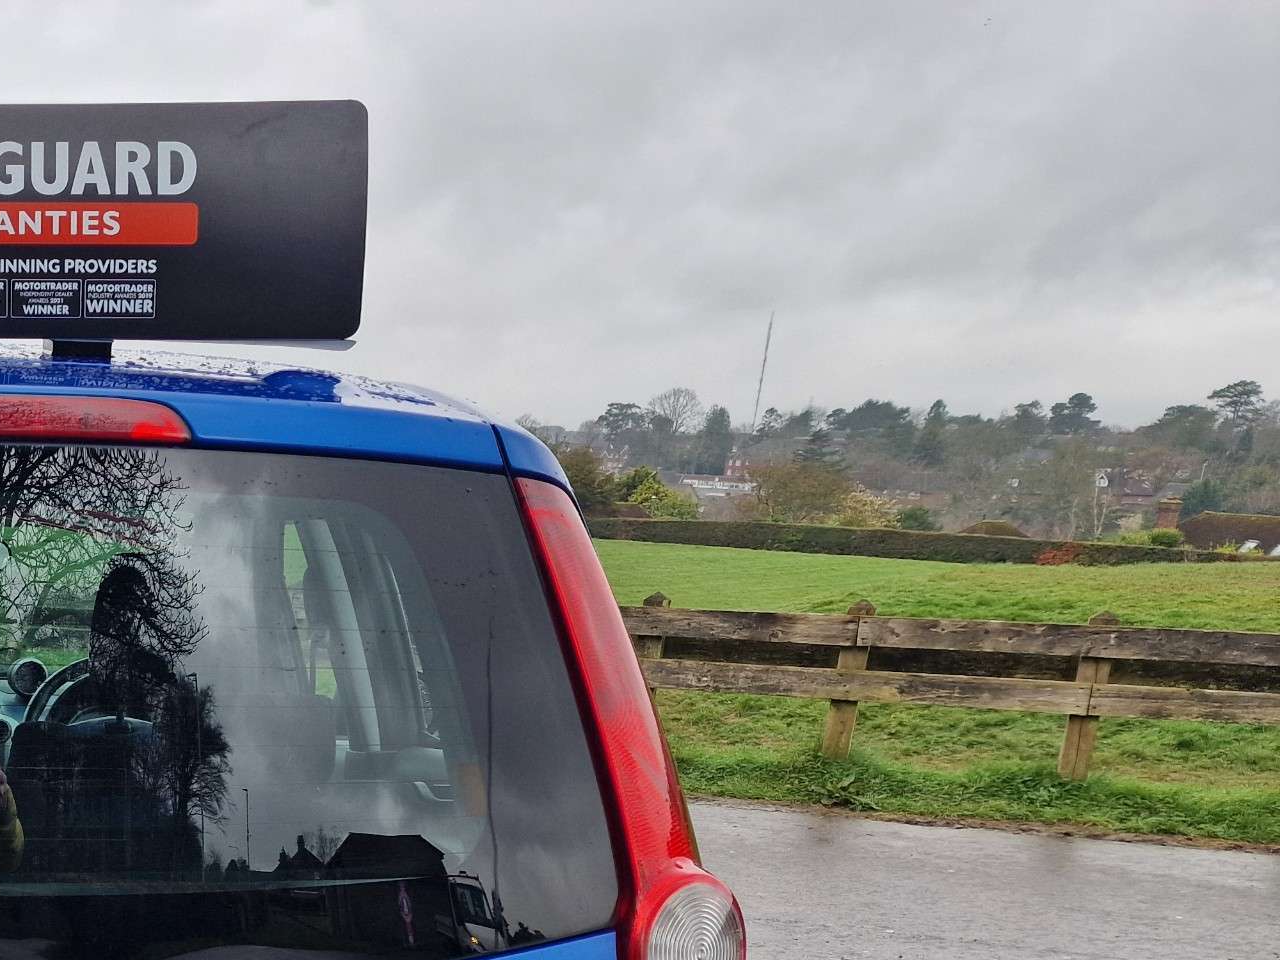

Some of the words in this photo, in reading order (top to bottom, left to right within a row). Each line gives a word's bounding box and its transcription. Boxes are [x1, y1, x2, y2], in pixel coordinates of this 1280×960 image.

[64, 259, 158, 275] PROVIDERS
[14, 281, 79, 290] MOTORTRADER
[87, 283, 154, 293] MOTORTRADER
[22, 304, 69, 315] WINNER
[86, 299, 154, 313] WINNER
